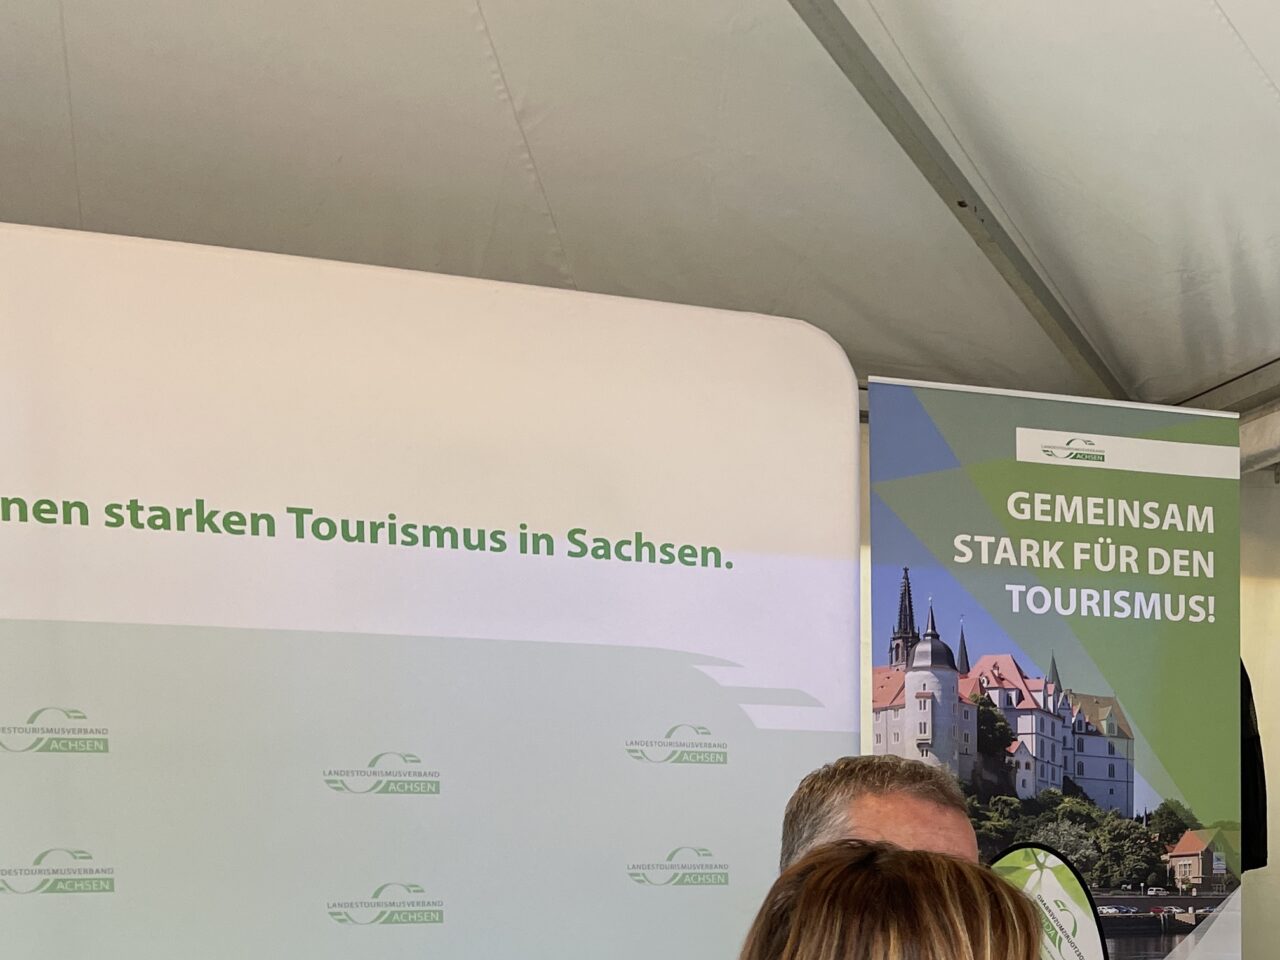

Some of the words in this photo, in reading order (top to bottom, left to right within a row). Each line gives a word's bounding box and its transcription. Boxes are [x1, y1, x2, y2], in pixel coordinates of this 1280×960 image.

[1006, 491, 1215, 533] GEMEINSAM
[103, 498, 277, 538] starken
[286, 506, 509, 554] Tourismus
[518, 523, 556, 557] in
[566, 527, 735, 570] Sachsen.
[953, 533, 1065, 570] STARK
[1073, 537, 1139, 575] FÜR
[1147, 548, 1215, 579] DEN
[1005, 583, 1216, 624] TOURISMUS!
[50, 740, 104, 751] ACHSEN
[682, 752, 724, 762] ACHSEN
[323, 769, 440, 778] LANDESTOURISMUSVERBAND
[388, 782, 436, 793] ACHSEN
[56, 880, 110, 891] ACHSEN
[392, 911, 439, 922] ACHSEN
